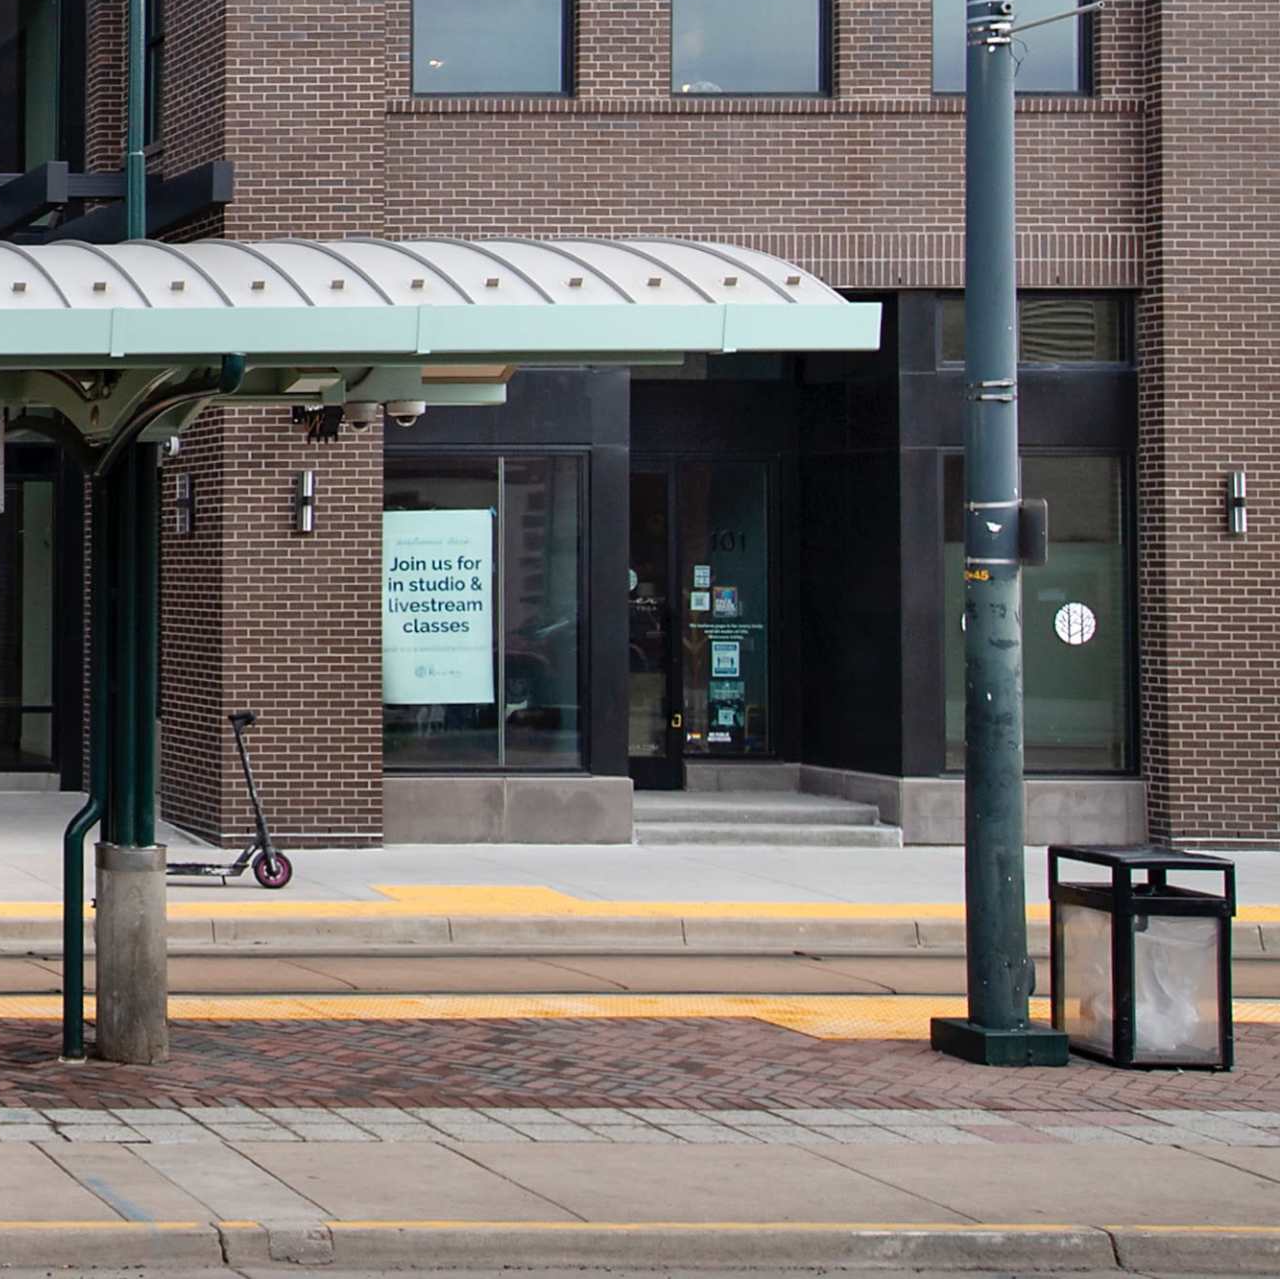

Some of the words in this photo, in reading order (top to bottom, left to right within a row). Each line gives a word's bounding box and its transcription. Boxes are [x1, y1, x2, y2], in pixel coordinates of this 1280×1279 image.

[389, 556, 426, 571] Join
[432, 559, 452, 571] us
[457, 555, 482, 570] for
[387, 577, 403, 592] in
[409, 575, 465, 592] studio
[471, 576, 482, 591] &
[387, 598, 483, 613] livestream
[403, 618, 470, 633] classes
